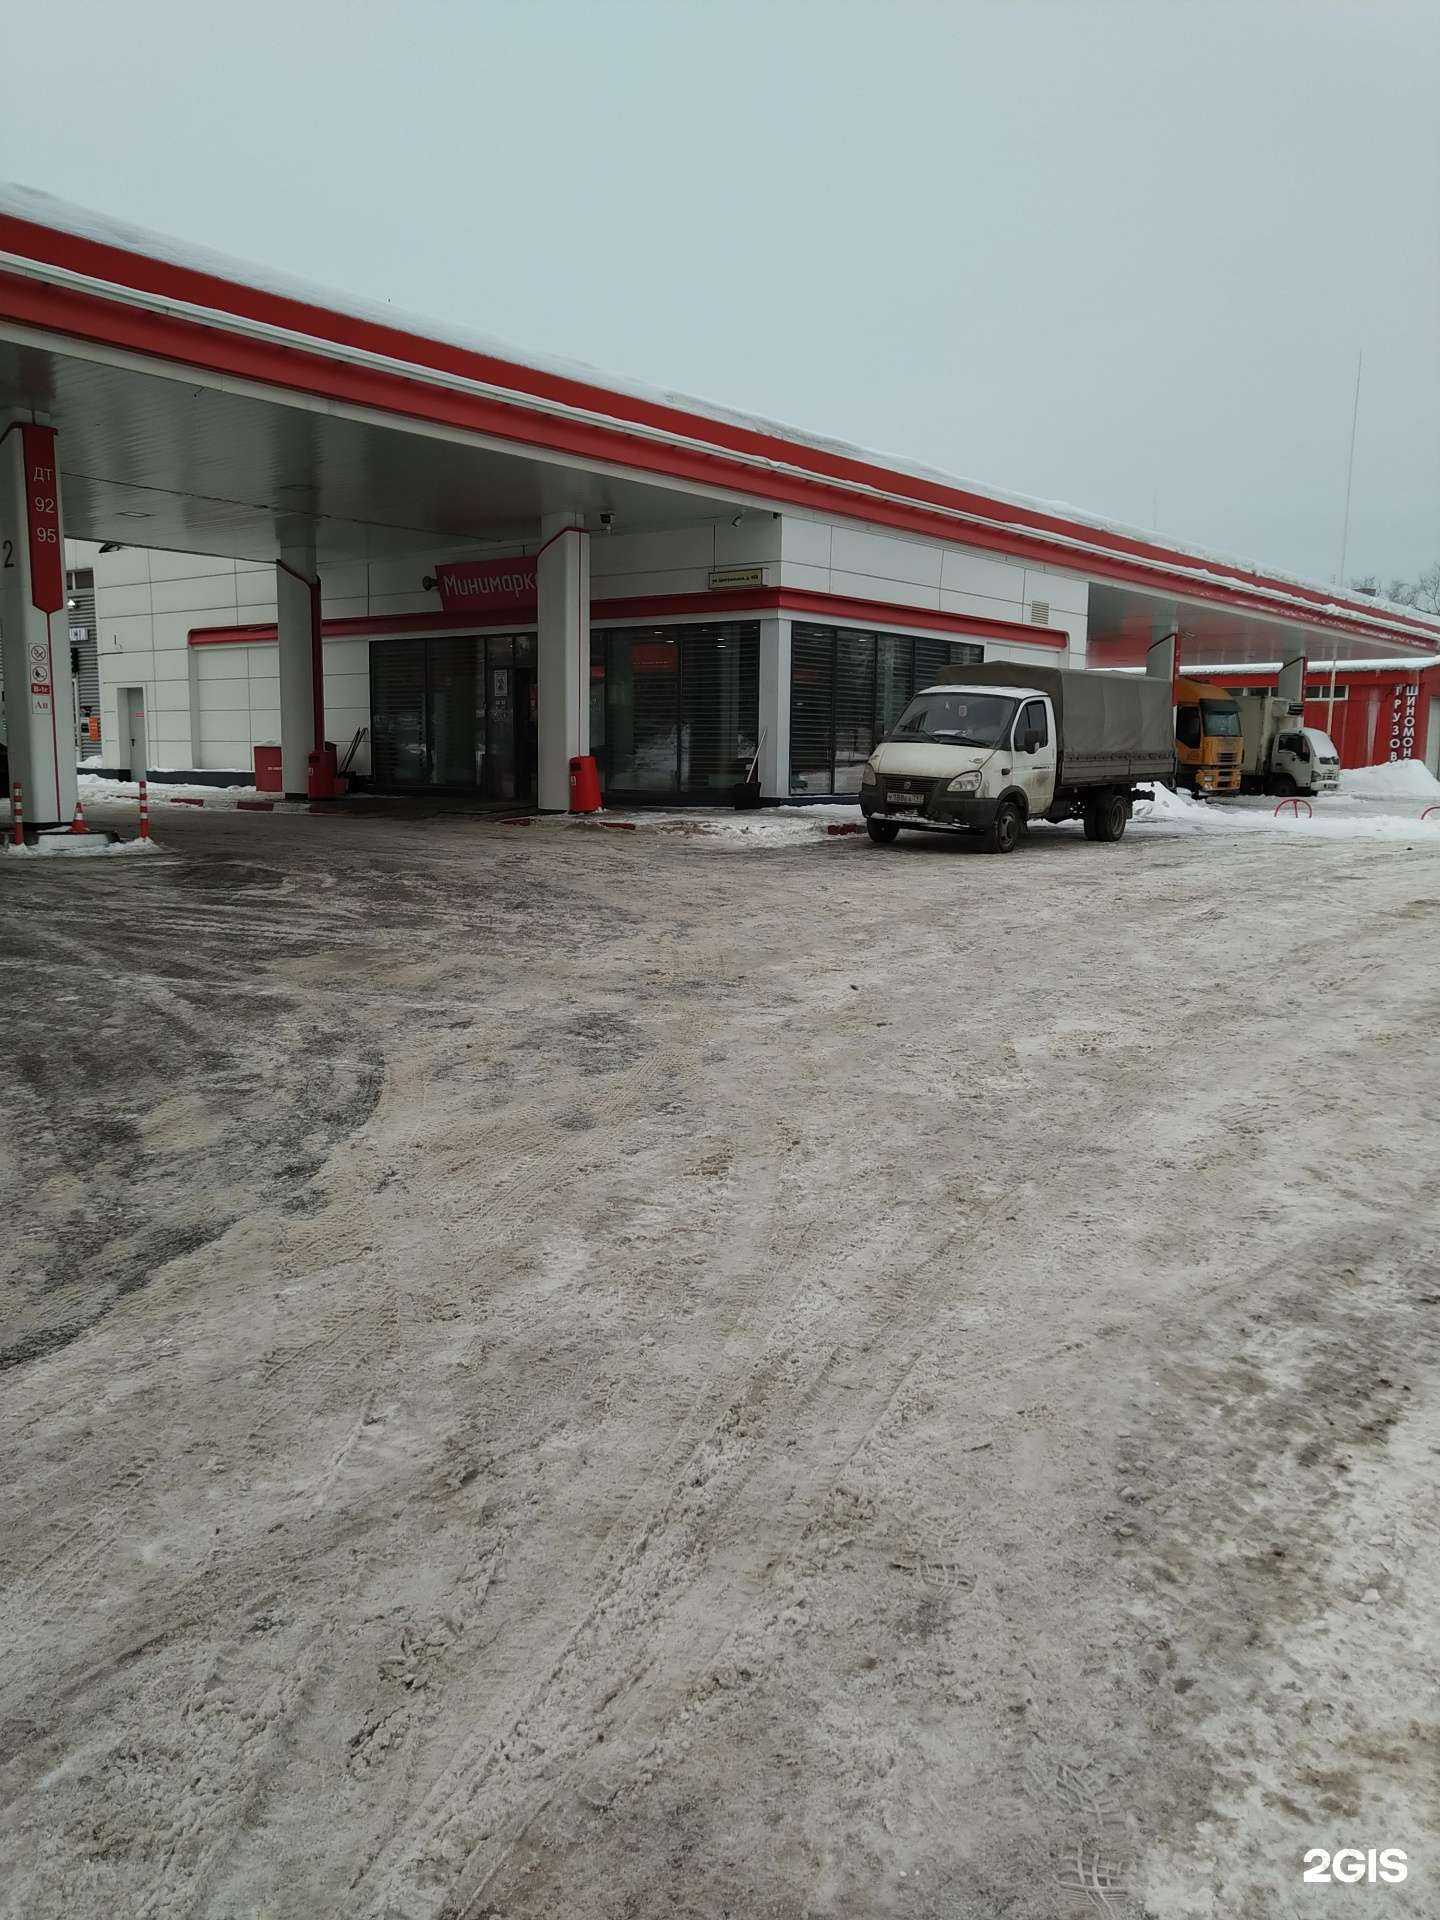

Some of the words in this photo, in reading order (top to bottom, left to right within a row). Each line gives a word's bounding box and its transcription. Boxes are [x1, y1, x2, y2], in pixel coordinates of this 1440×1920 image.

[33, 466, 53, 483] ДТ
[35, 497, 55, 513] 92
[37, 527, 56, 543] 95
[2, 541, 15, 568] 2
[443, 572, 537, 600] Минимарк
[1402, 686, 1418, 760] ШИНОМОН
